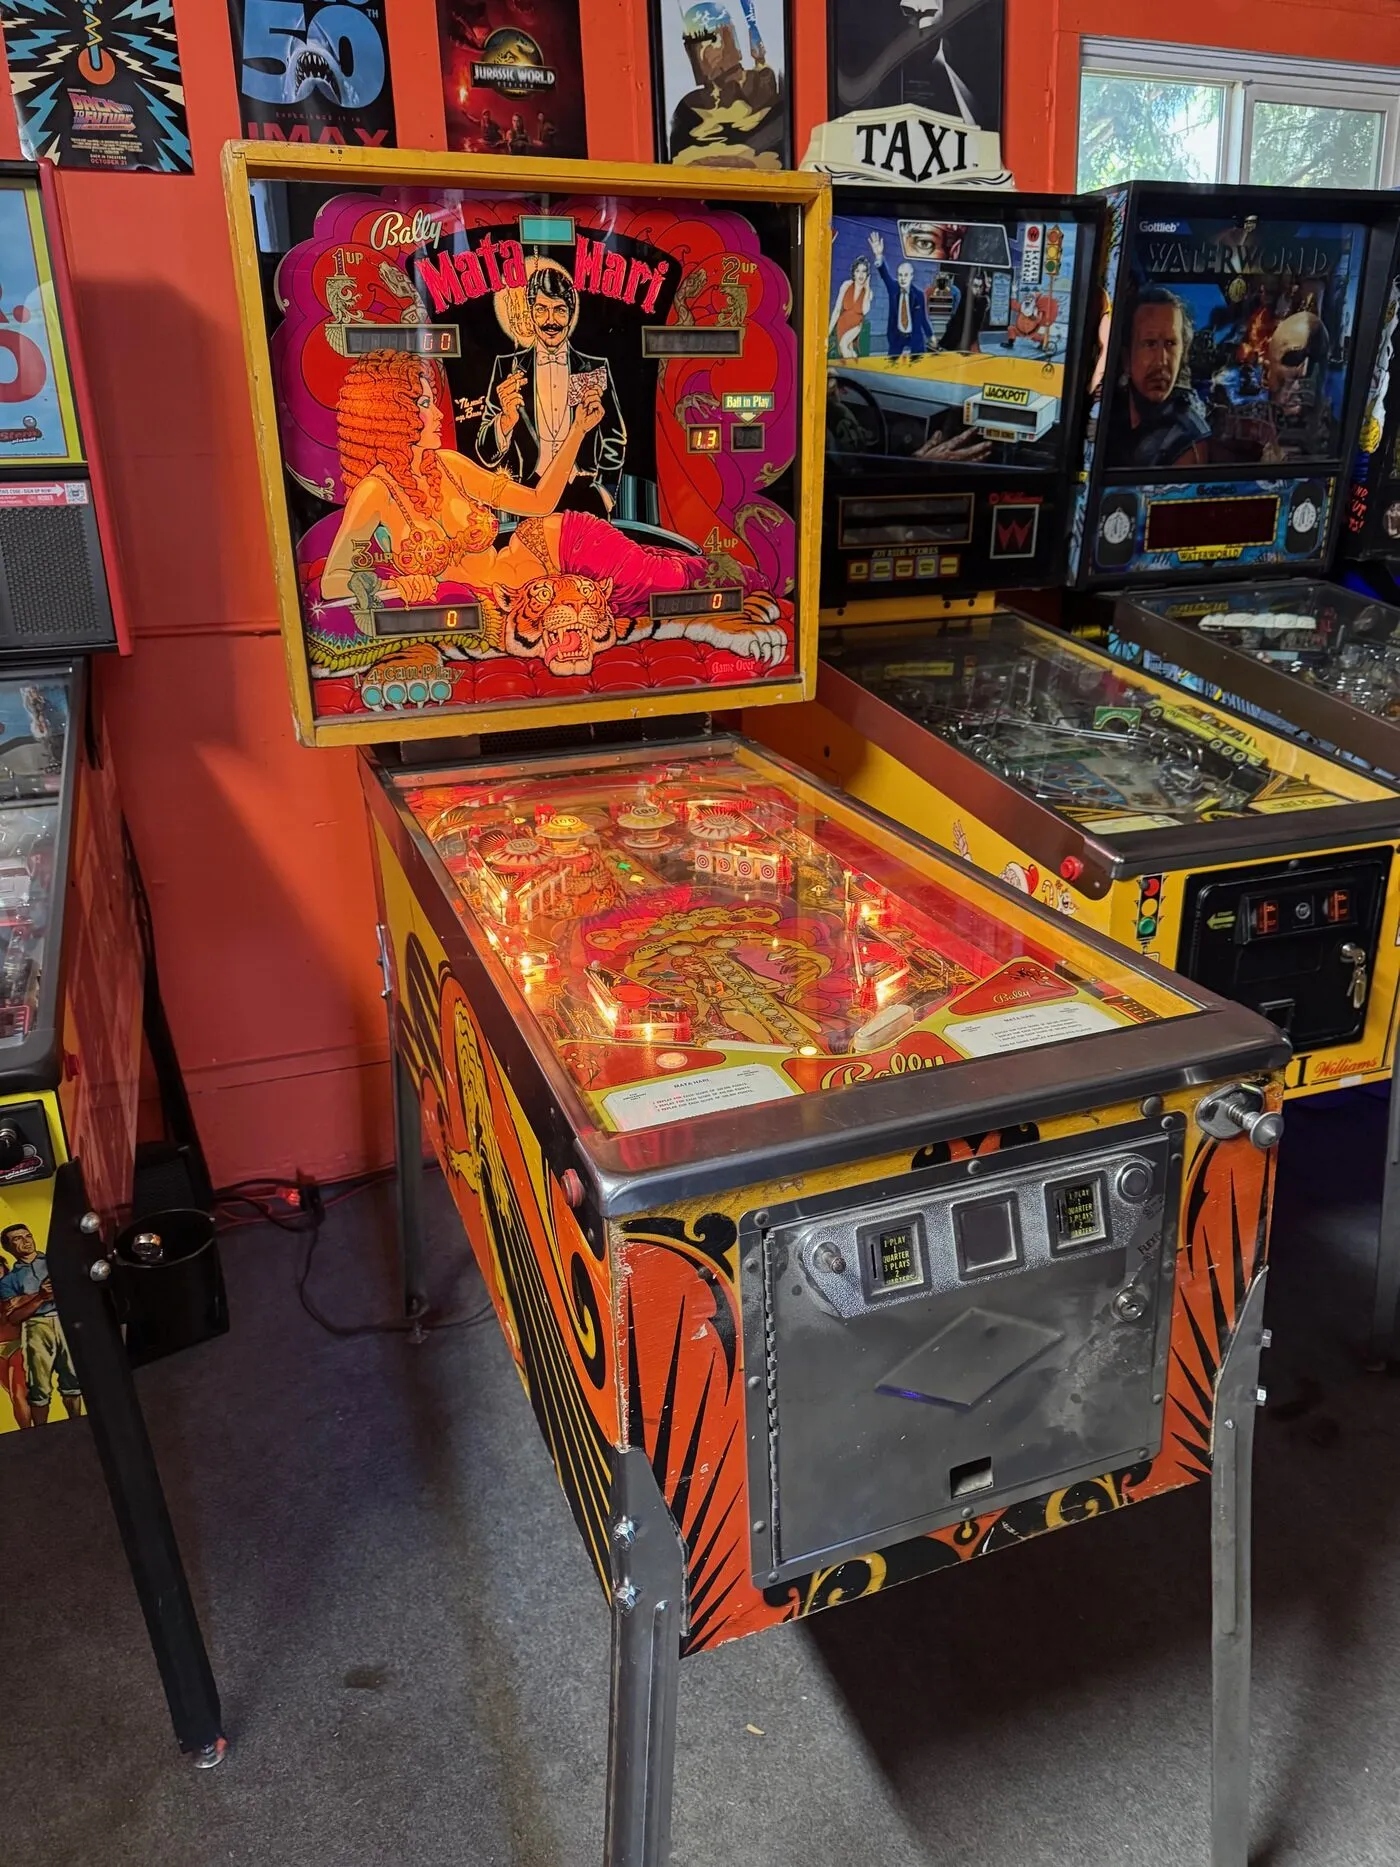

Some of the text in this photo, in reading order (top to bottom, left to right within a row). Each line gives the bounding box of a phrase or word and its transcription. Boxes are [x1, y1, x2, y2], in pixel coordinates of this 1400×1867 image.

[474, 65, 555, 84] JURASSIC WORLD
[68, 92, 124, 113] BACK
[84, 111, 134, 124] FUTURE
[856, 119, 968, 183] TAXI
[371, 209, 442, 250] Bally
[1139, 221, 1177, 233] Gottlieb
[1149, 242, 1330, 276] WATERWORLD
[414, 232, 669, 315] Mata Hari
[726, 395, 742, 409] Ball
[752, 395, 770, 409] Play
[985, 386, 1027, 403] JACKPOT
[712, 593, 722, 609] 0
[446, 611, 458, 627] 0
[383, 665, 418, 681] Can
[421, 662, 465, 684] Play
[712, 659, 756, 675] Game Over
[993, 989, 1032, 1004] Bally
[1315, 1056, 1379, 1078] Williams
[889, 1235, 906, 1246] PLAY
[882, 1250, 910, 1264] QUARTER
[890, 1259, 911, 1270] PLAYS
